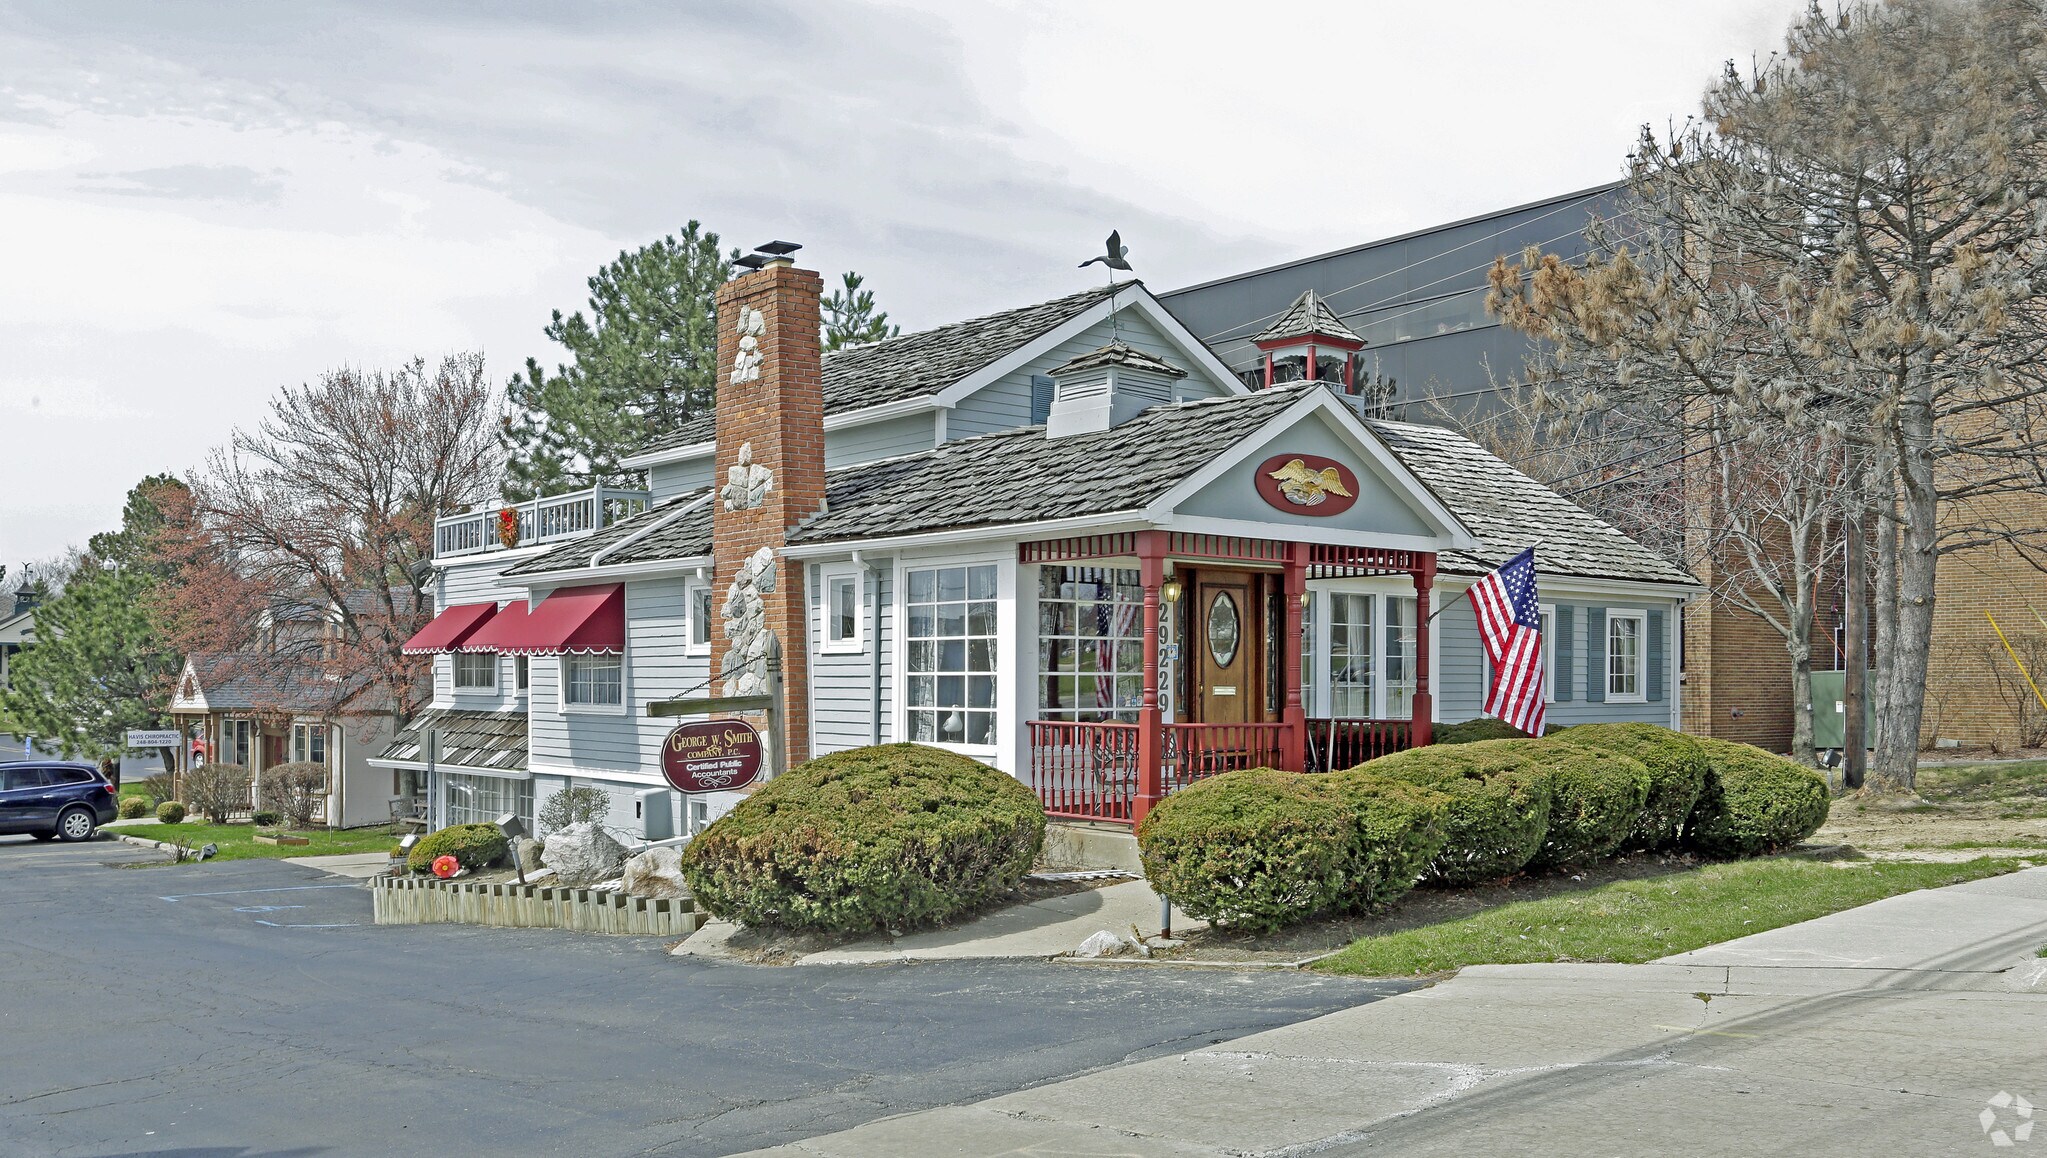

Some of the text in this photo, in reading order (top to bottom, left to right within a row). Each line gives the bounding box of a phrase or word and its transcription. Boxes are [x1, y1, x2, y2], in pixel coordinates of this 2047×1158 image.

[1159, 602, 1169, 713] 29229
[712, 735, 722, 744] W.
[727, 748, 741, 756] P.C.
[686, 760, 743, 771] Certified Public
[692, 769, 738, 778] Accountants
